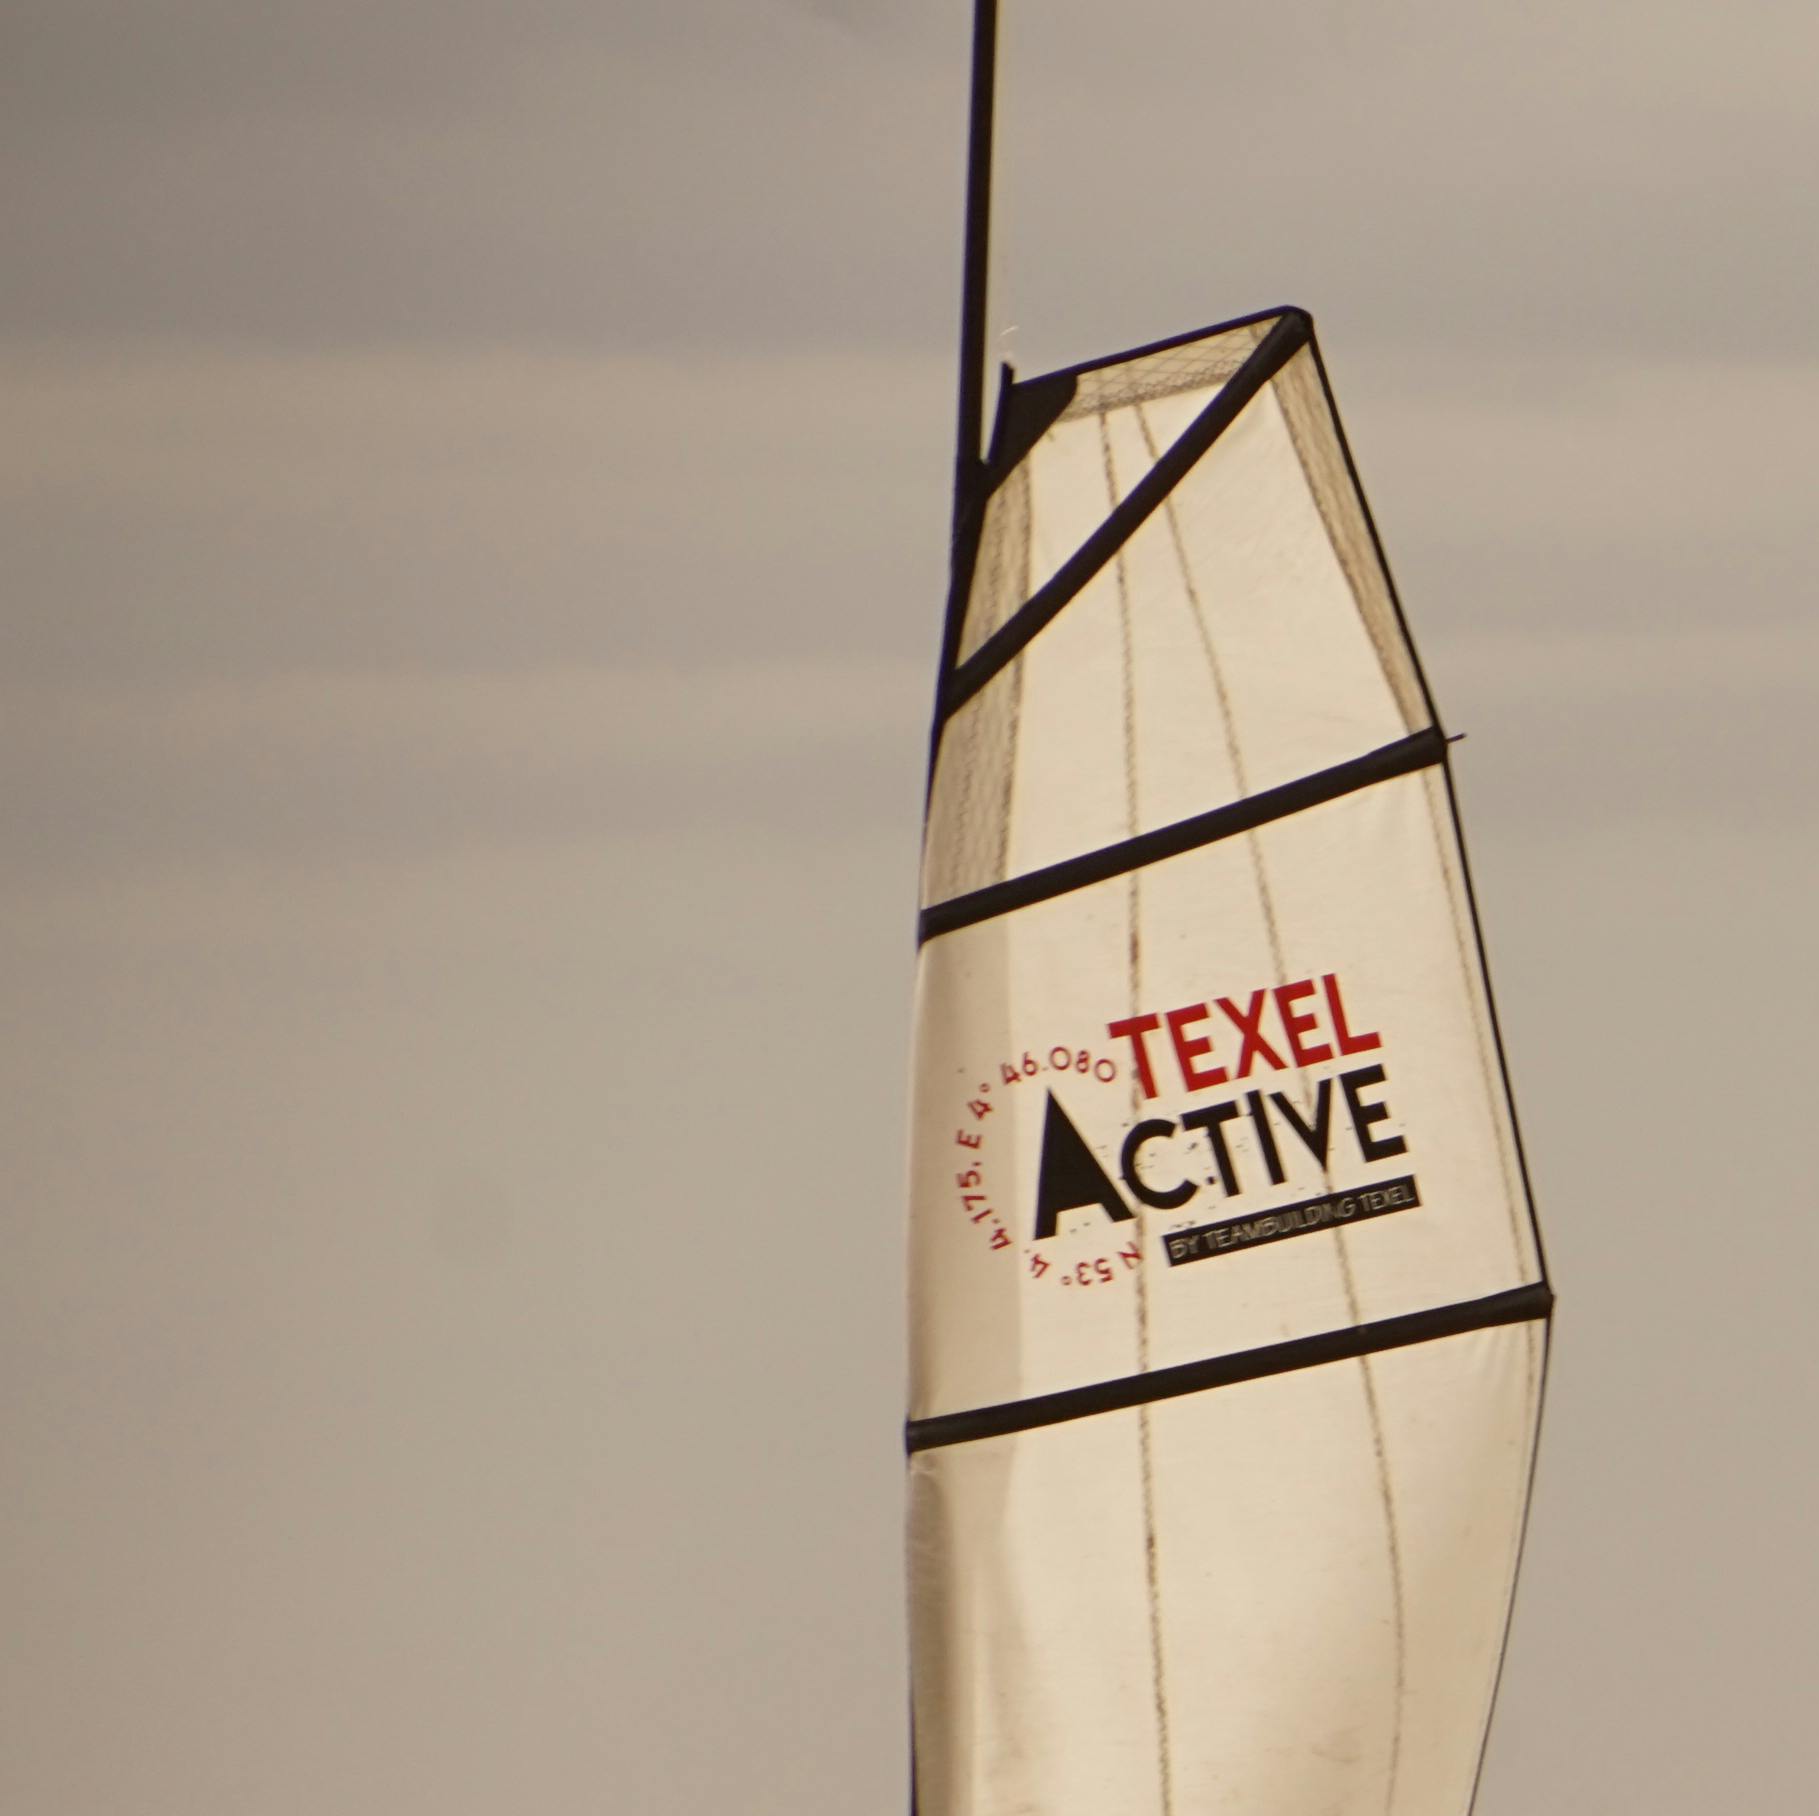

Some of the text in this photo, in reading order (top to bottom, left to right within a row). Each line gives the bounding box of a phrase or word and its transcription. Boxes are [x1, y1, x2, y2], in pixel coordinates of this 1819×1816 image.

[1000, 1046, 1117, 1085] 46.080
[1107, 973, 1384, 1100] TEXEL
[956, 1129, 982, 1150] E
[1033, 1063, 1409, 1240] ACTIVE
[1168, 1183, 1416, 1260] BY TEAMBUILDING TEXEL
[1118, 1241, 1144, 1269] N
